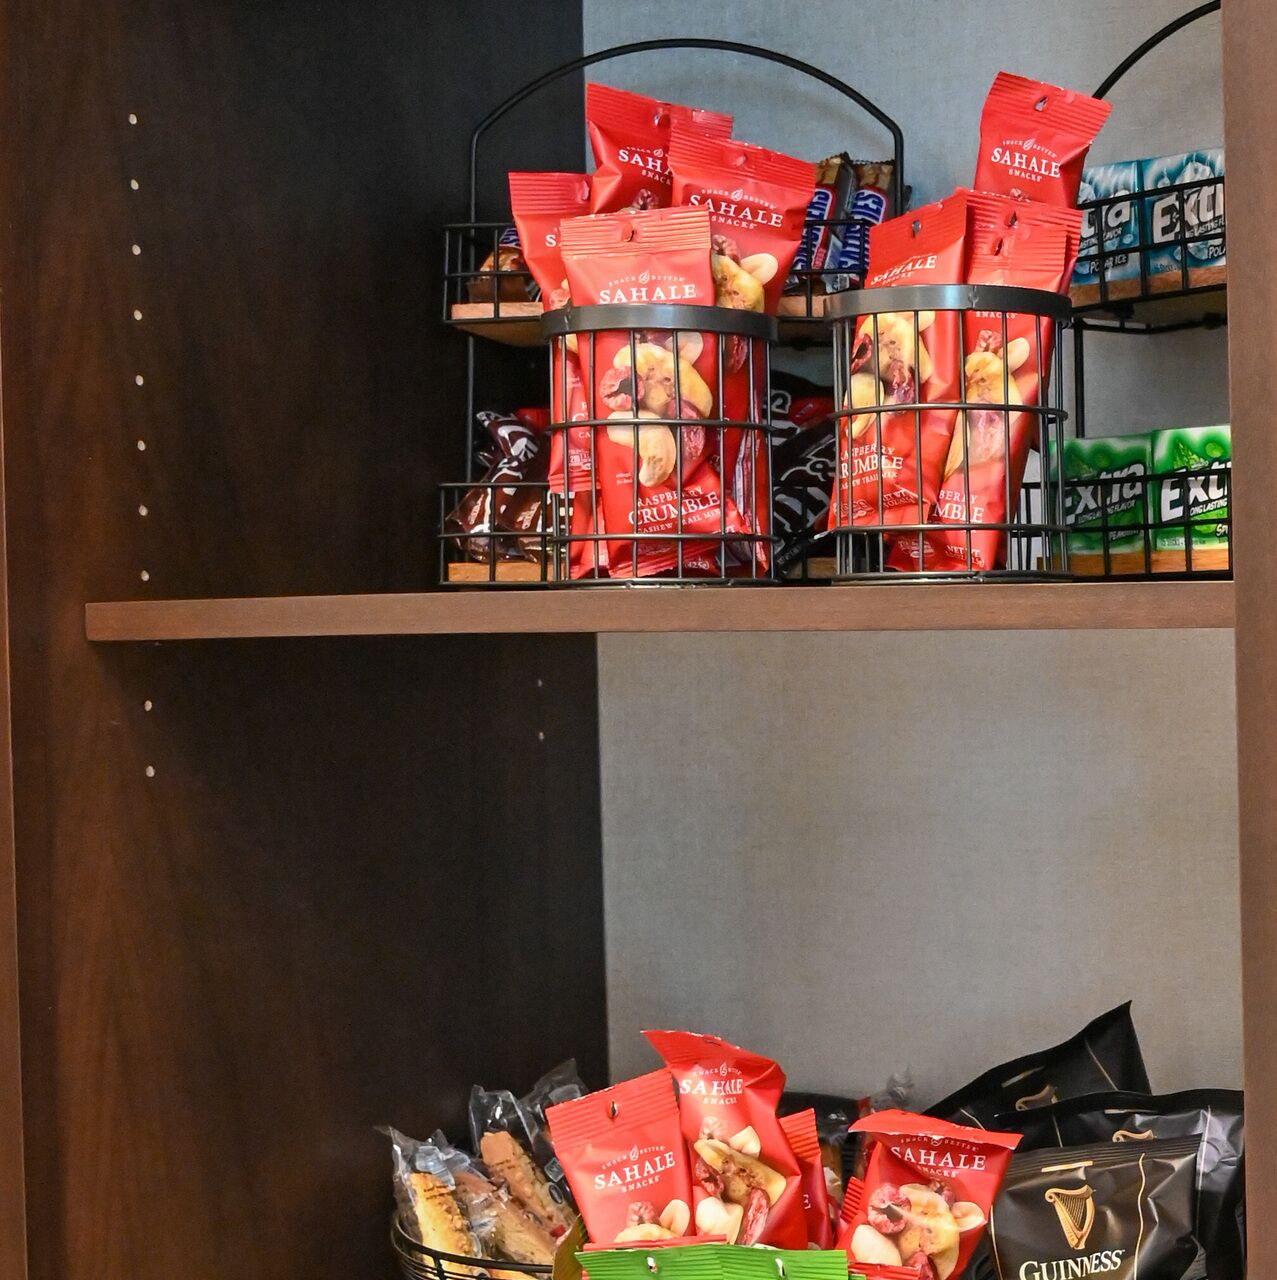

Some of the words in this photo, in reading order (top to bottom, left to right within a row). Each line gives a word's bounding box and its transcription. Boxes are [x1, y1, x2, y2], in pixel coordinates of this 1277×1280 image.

[990, 147, 1062, 178] SAHALE
[1008, 168, 1042, 182] SNACKS
[688, 194, 784, 228] SAHALE
[711, 215, 755, 230] SNACKS
[870, 255, 938, 285] SAHALE
[600, 284, 697, 305] SAHALE
[841, 453, 904, 479] RUMBLE
[628, 491, 720, 526] CRUMBLE
[1203, 499, 1227, 513] LASTING
[679, 1078, 744, 1097] SAHALE
[594, 1151, 677, 1191] SAHALE
[890, 1145, 987, 1171] SAHALE
[620, 1175, 660, 1194] SNACKS
